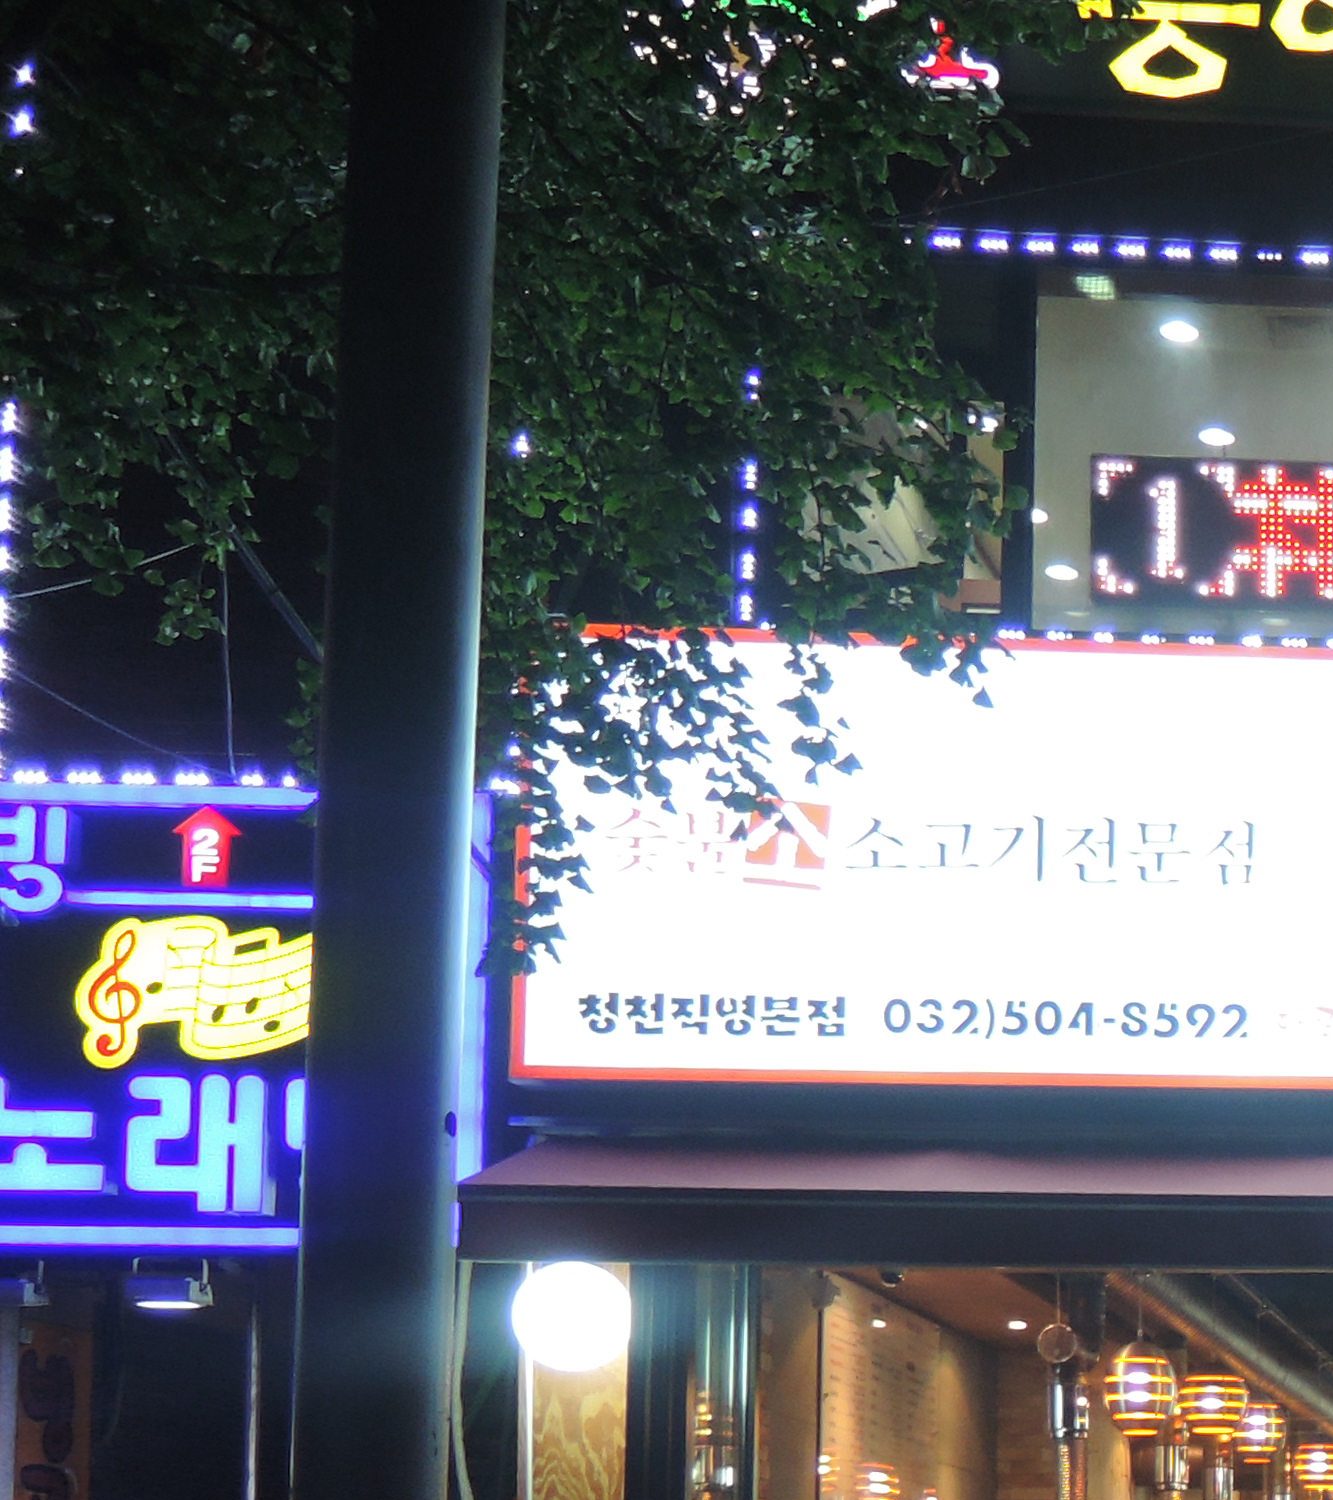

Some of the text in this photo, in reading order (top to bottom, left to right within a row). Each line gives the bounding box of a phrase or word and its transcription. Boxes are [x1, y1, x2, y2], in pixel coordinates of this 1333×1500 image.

[846, 814, 1258, 887] 소고기전문점
[578, 992, 846, 1037] 청천직영본점
[883, 998, 1249, 1039] 032)504-8592
[0, 1073, 307, 1212] 노래
